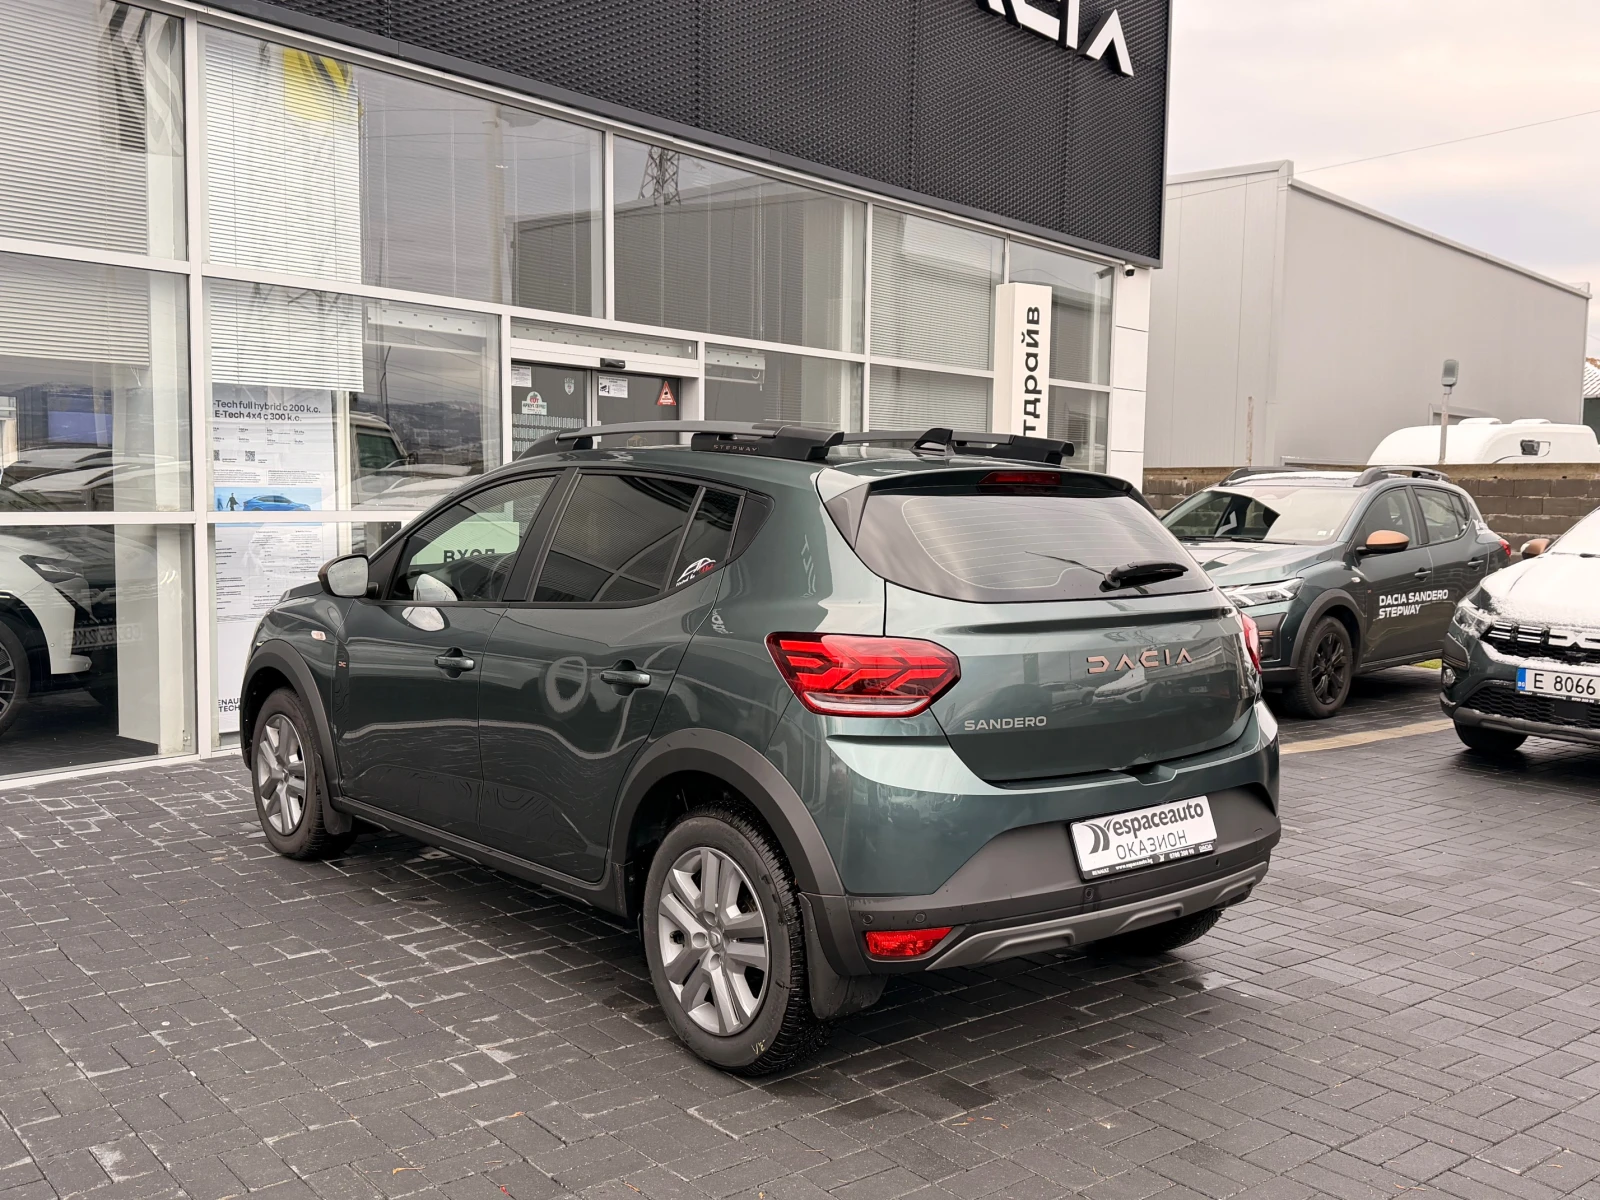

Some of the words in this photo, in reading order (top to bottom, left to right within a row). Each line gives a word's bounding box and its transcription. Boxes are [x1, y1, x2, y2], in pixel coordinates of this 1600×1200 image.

[239, 400, 252, 410] full
[254, 401, 282, 412] hybrid
[289, 404, 305, 412] 200
[214, 410, 245, 419] E-Tech
[245, 411, 262, 420] 4x4
[270, 413, 286, 421] 300
[713, 444, 758, 452] STEPWAY
[1379, 592, 1407, 607] DACIA
[1408, 589, 1449, 603] SANDERO
[1379, 604, 1420, 619] STEPWAY
[1086, 647, 1193, 674] DACIA
[1553, 675, 1596, 696] 8066
[964, 715, 1047, 731] SANDERO
[1112, 801, 1204, 839] espaceauto
[1115, 829, 1188, 860] ОКАЗИОН
